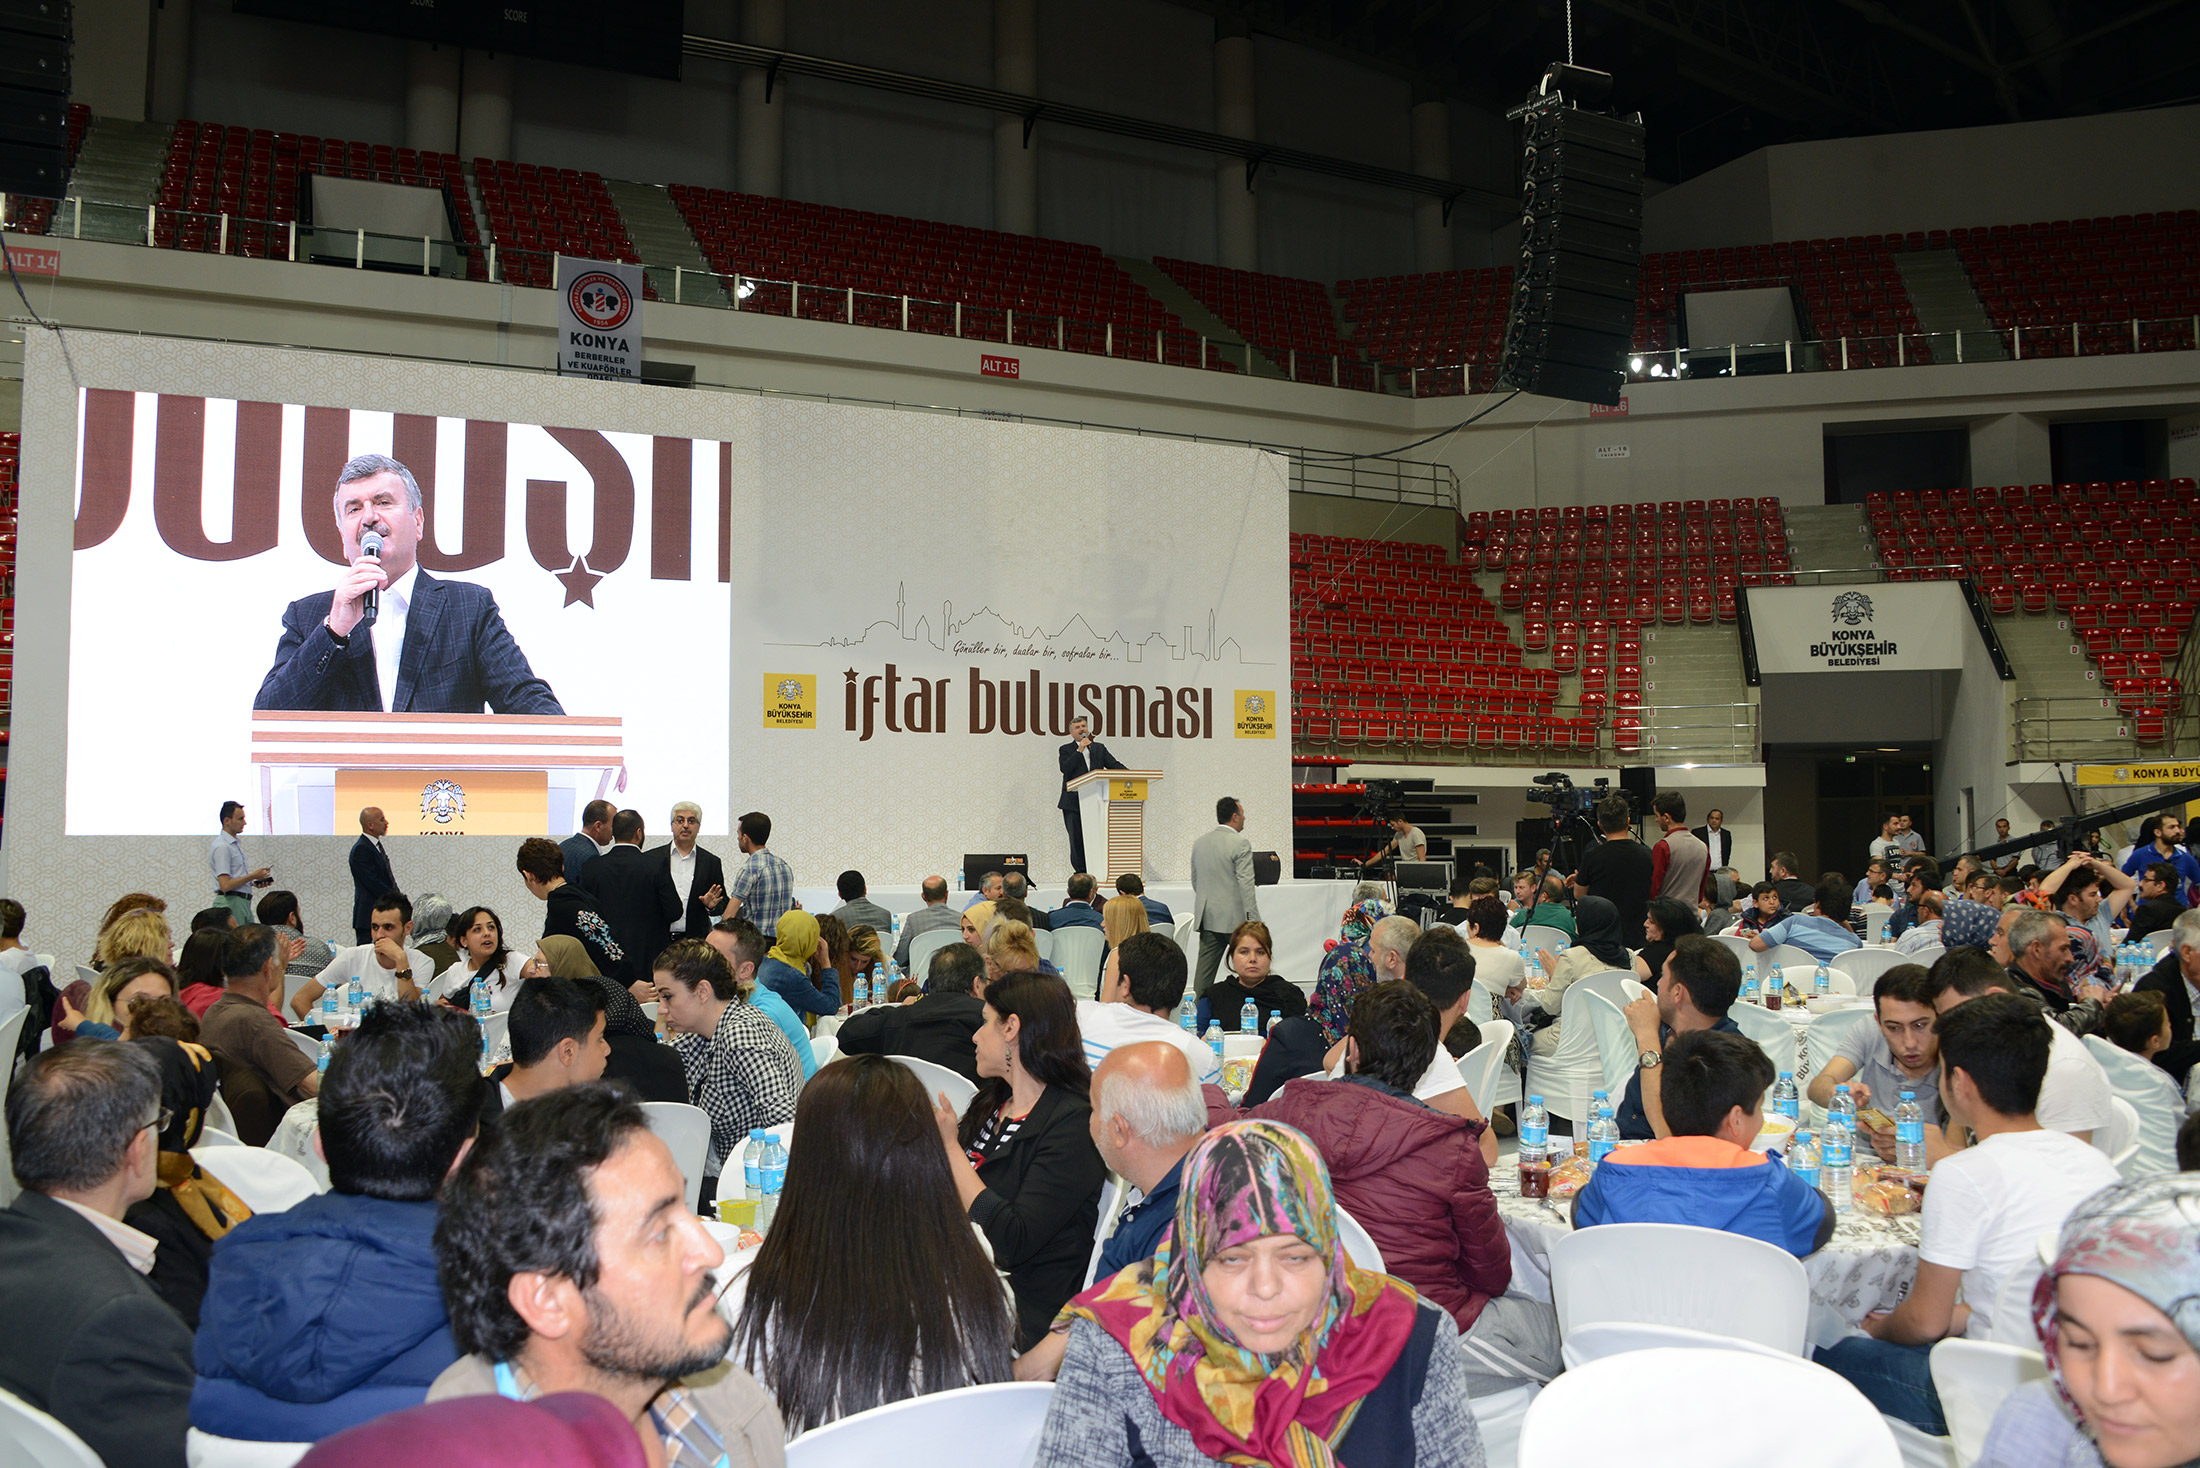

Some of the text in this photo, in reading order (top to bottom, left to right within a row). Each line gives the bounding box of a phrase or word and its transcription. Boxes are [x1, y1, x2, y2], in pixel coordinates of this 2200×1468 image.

[504, 8, 528, 22] SCORE
[6, 252, 58, 270] ALT 14
[570, 332, 630, 352] KONYA
[574, 352, 626, 364] BERBERLER
[581, 362, 632, 376] KUAFÖRLER
[982, 360, 1018, 374] ALT 15
[1832, 630, 1875, 640] KONYA
[953, 640, 990, 656] Gönüller
[993, 643, 1008, 658] bir,
[1012, 644, 1040, 656] dualar
[1042, 644, 1057, 660] bir,
[1061, 646, 1096, 662] sofralar
[1810, 640, 1898, 657] BÜYÜKŞEHİR
[1828, 656, 1880, 666] BELEDİYESİ
[767, 709, 812, 718] BÜYÜKŞEHİR
[2133, 768, 2169, 778] KONYA
